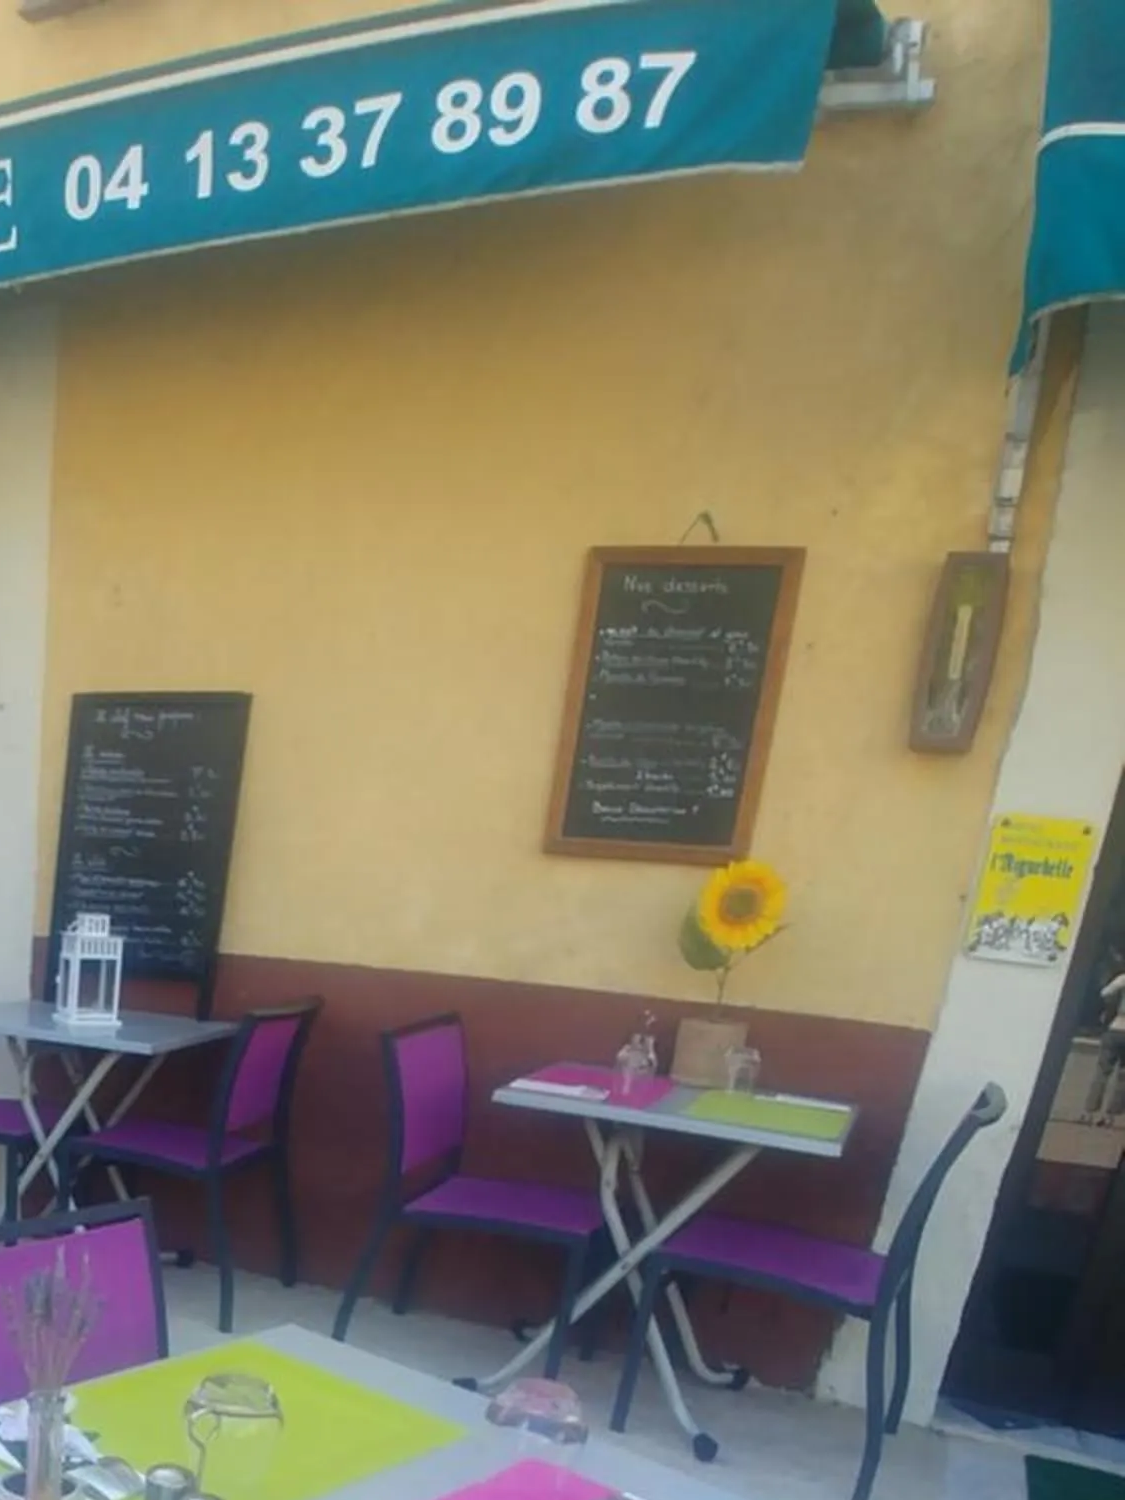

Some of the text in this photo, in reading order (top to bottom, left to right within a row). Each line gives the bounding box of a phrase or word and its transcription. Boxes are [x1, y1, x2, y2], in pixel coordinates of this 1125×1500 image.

[64, 145, 148, 220] 04
[185, 122, 270, 199] 13
[299, 93, 402, 178] 37
[431, 72, 541, 154] 89
[576, 51, 698, 135] 87
